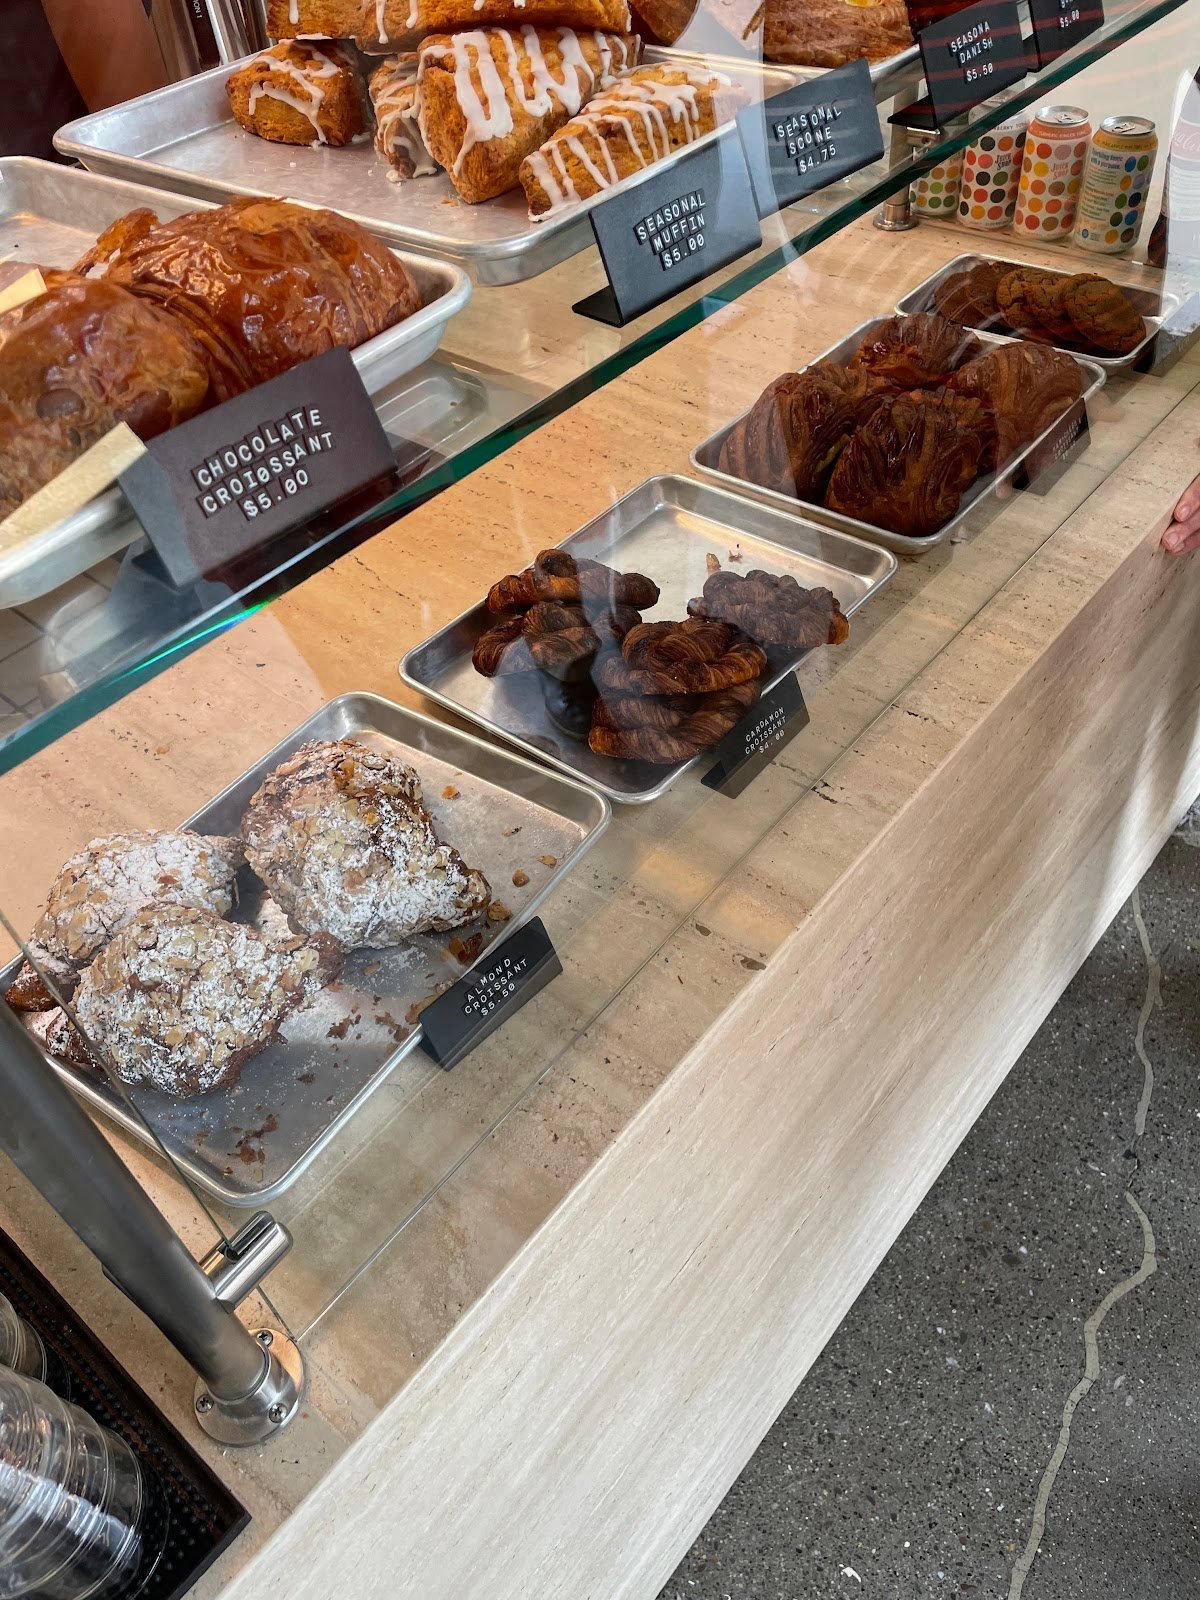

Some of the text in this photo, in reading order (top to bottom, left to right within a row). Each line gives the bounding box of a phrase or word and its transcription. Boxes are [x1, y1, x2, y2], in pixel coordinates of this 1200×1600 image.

[951, 21, 990, 53] SEASONA
[960, 37, 993, 64] DANISH
[966, 63, 993, 82] $5.50
[777, 106, 842, 138] SEASONAL
[789, 127, 832, 154] SCONE
[799, 144, 836, 173] $4.75
[637, 194, 706, 240] SEASONAL
[653, 213, 705, 251] MUFFIN
[664, 233, 705, 267] $5.00
[197, 409, 322, 486] CHOCOLATE
[243, 469, 308, 517] $5.00
[745, 716, 786, 754] CROISSANT
[759, 730, 785, 753] $4.00
[464, 958, 527, 1014] CROISSANT
[467, 958, 511, 1002] ALMOND
[480, 983, 515, 1016] $5.50
